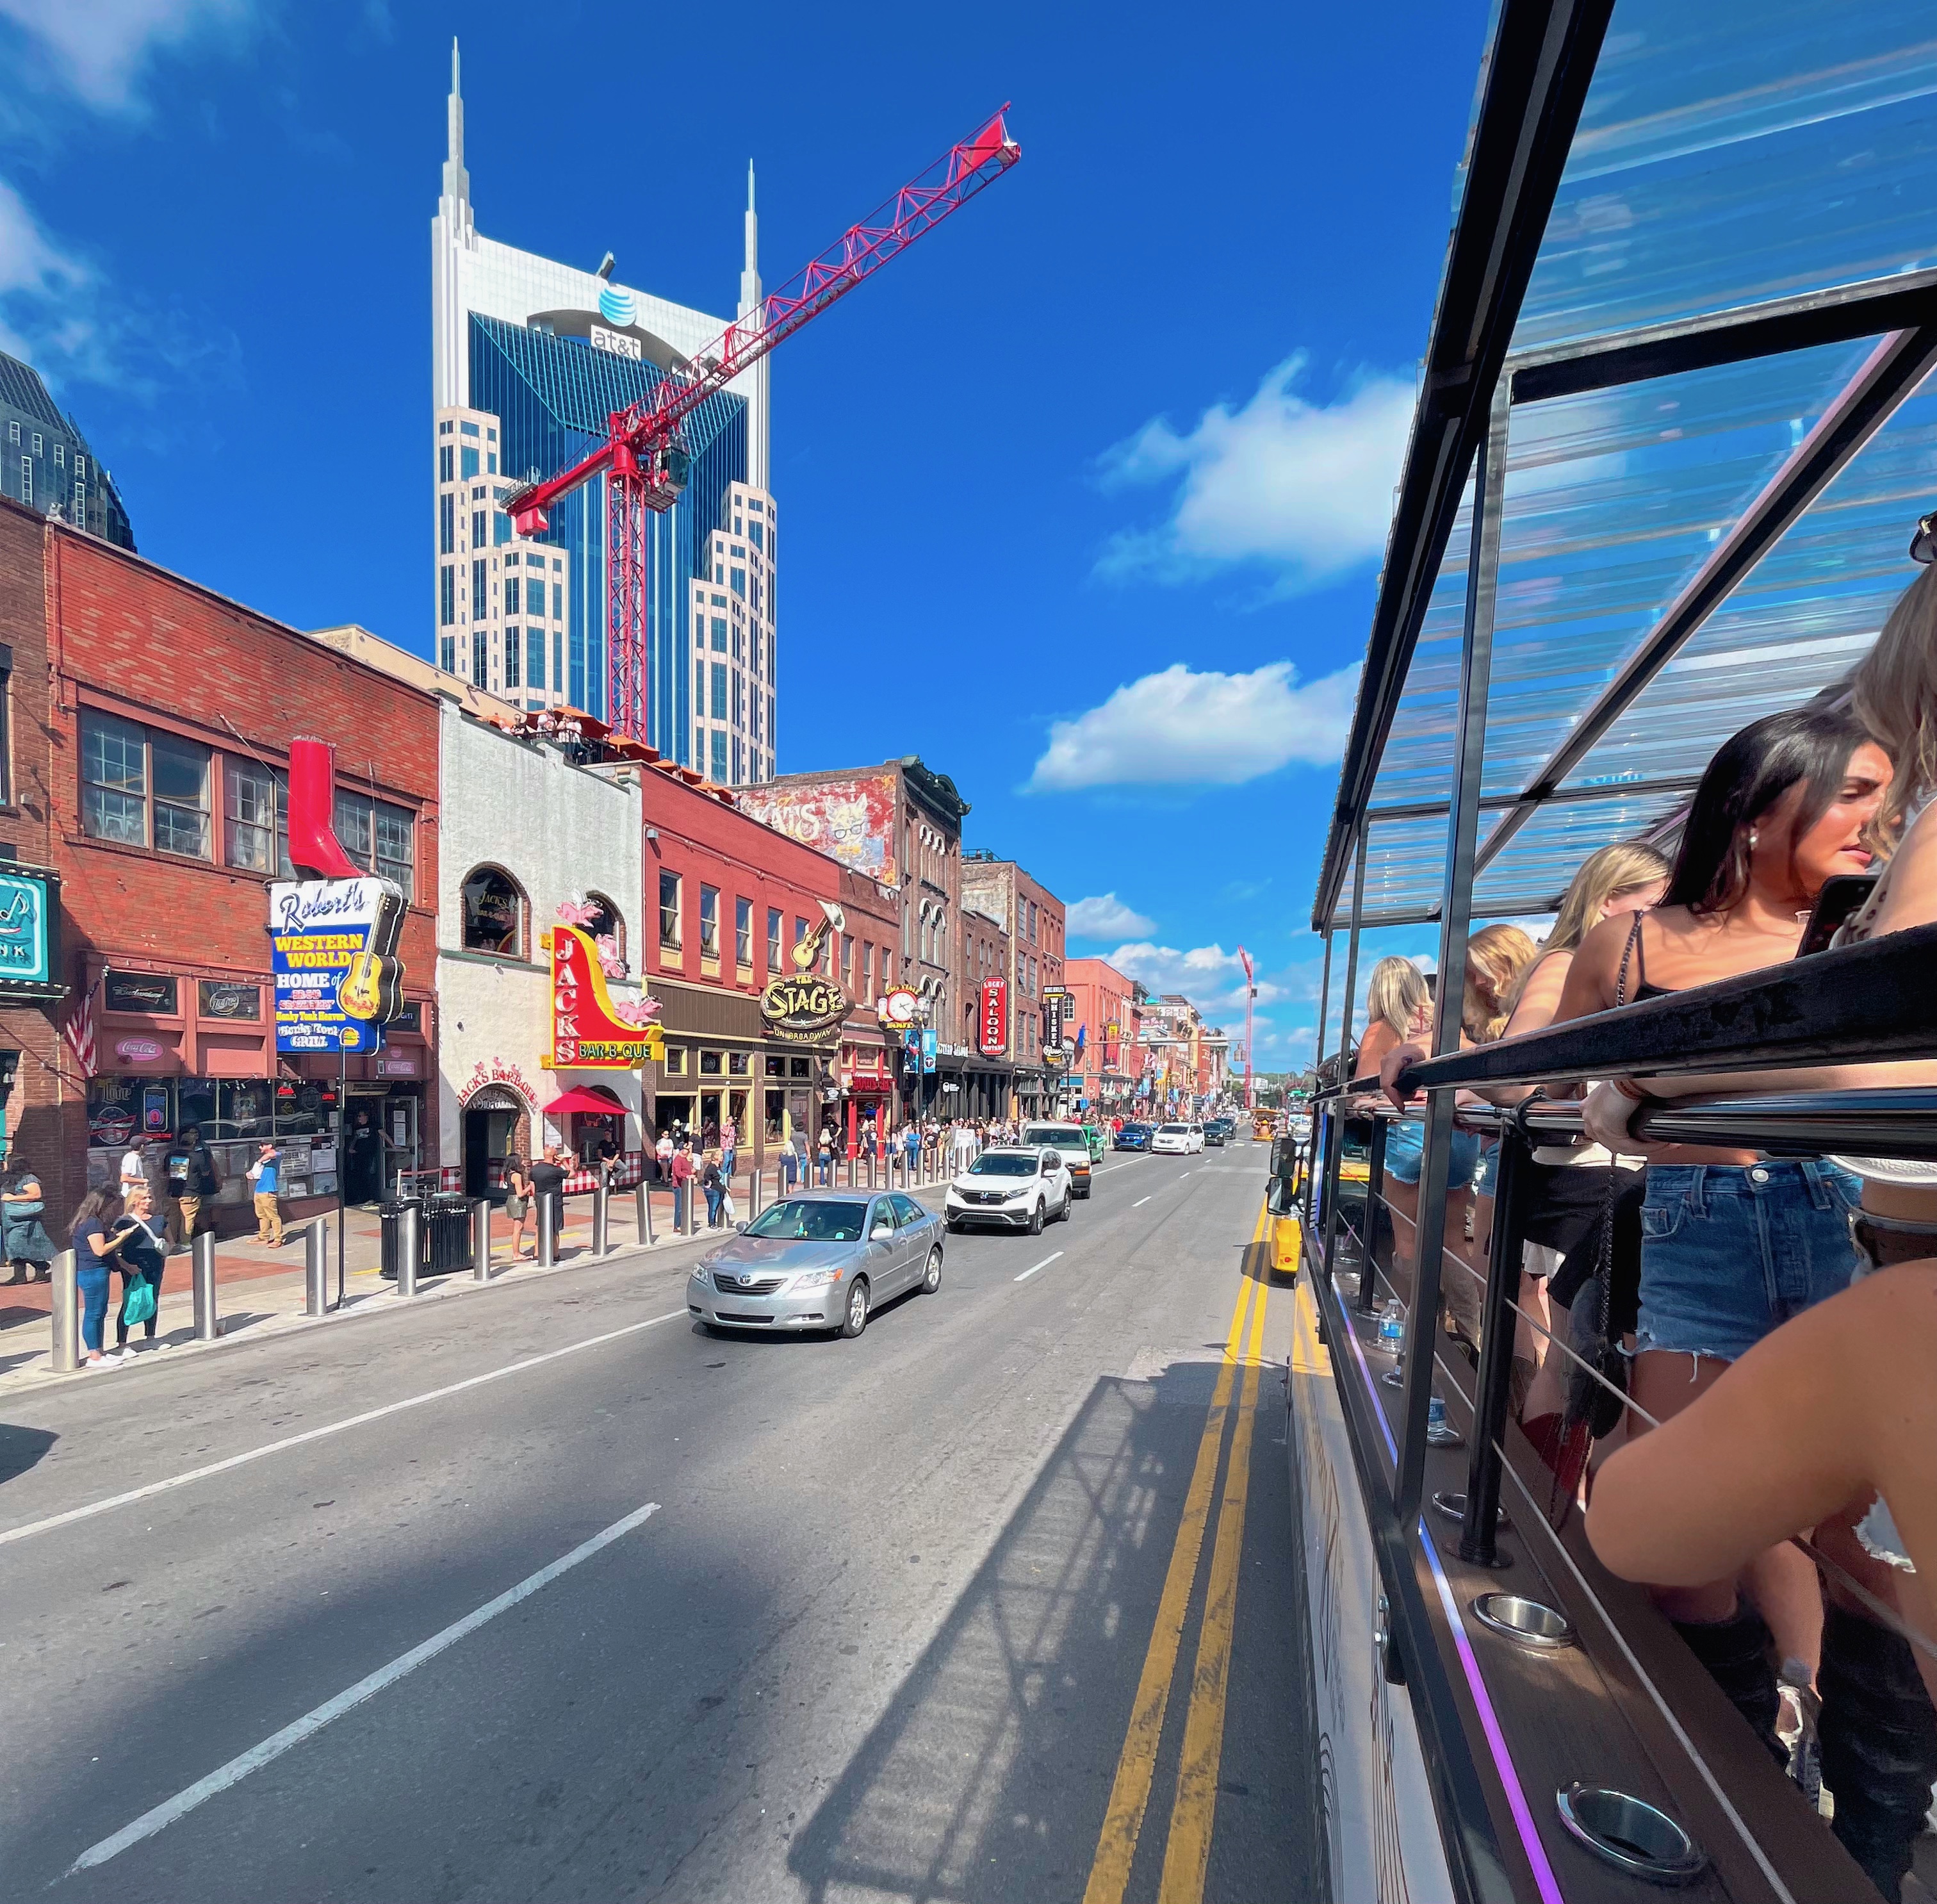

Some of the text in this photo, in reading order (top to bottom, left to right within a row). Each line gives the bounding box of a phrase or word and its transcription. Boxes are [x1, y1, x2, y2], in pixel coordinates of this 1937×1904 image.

[594, 331, 639, 361] at&t
[274, 933, 364, 952] WESTERN
[286, 951, 351, 968] WORLD
[277, 971, 343, 990] HOME of
[796, 974, 813, 985] THE
[555, 937, 581, 1064] JACKS
[765, 981, 844, 1019] STAGE
[276, 1011, 346, 1023] Honky Tonk Heaven
[986, 989, 999, 1046] SALOON
[1050, 997, 1059, 1047] WHISKEY
[290, 1035, 329, 1047] GRILL
[774, 1028, 832, 1041] ON BROADWAY
[578, 1044, 652, 1058] BAR-B-QUE
[456, 1070, 489, 1108] JACK'S
